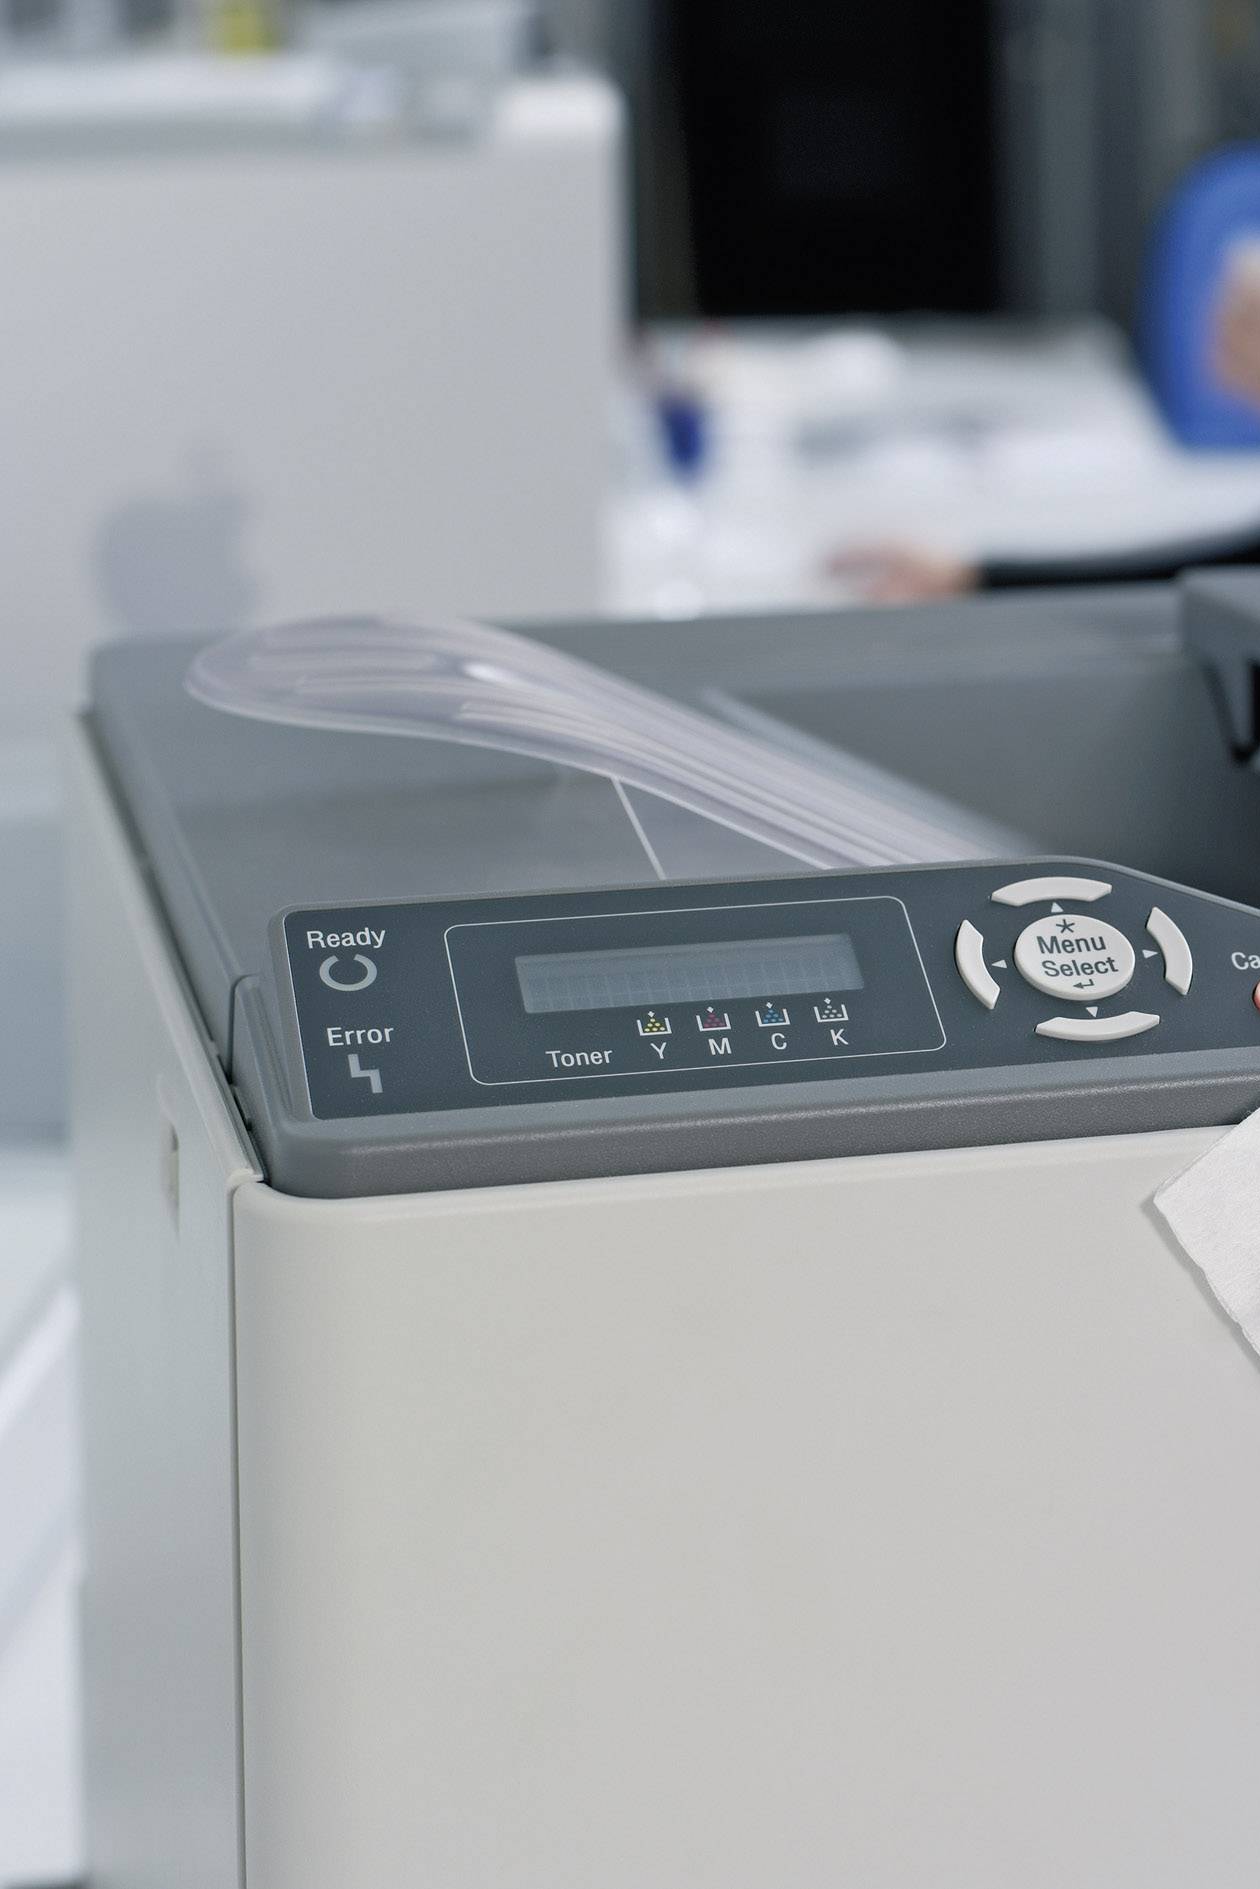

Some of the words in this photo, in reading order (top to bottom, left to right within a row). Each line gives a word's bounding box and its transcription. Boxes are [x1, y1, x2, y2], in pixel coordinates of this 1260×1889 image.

[306, 926, 386, 949] Ready
[1037, 934, 1107, 955] Menu
[1042, 956, 1119, 978] Select
[326, 1026, 394, 1047] Error
[545, 1049, 613, 1068] Toner
[650, 1041, 667, 1060] Y
[708, 1037, 732, 1056] M
[770, 1032, 788, 1050] C
[829, 1028, 849, 1046] K
